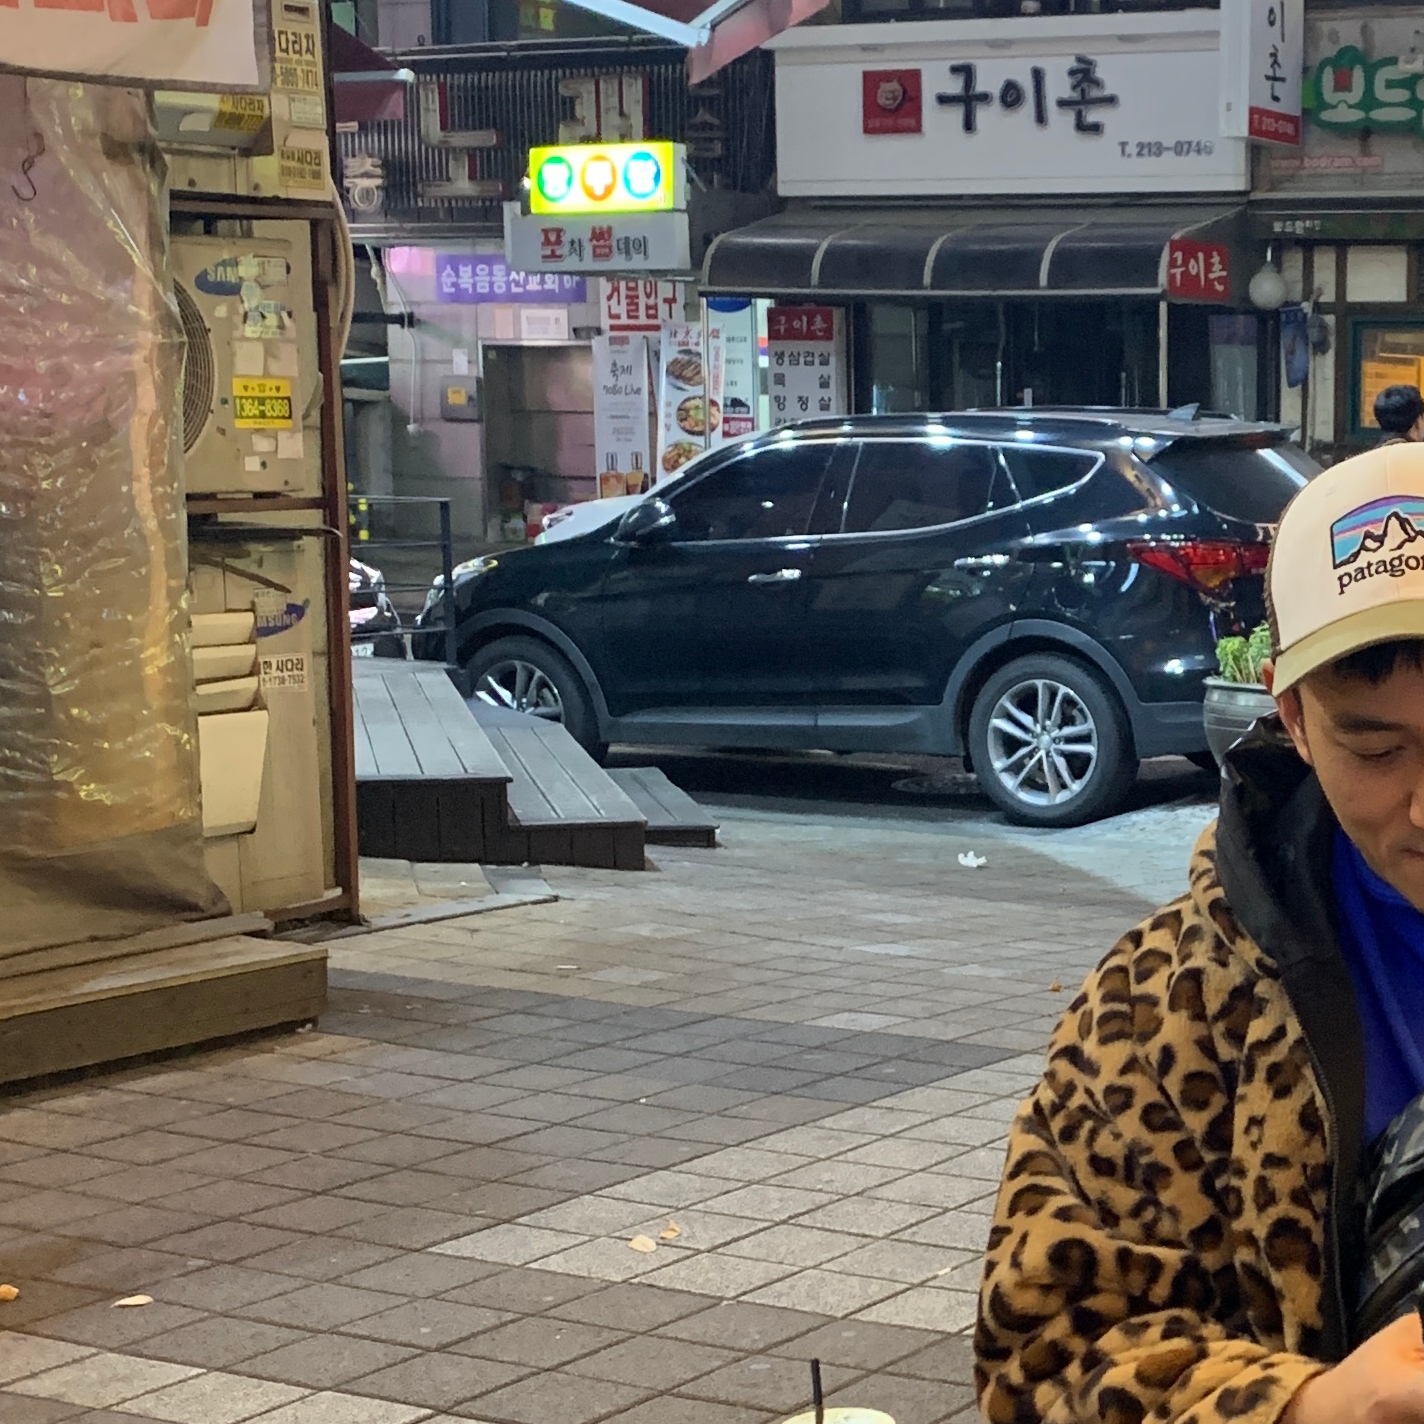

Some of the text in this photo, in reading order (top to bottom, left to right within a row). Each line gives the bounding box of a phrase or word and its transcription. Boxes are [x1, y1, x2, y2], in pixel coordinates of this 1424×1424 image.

[277, 29, 316, 59] 다리차
[934, 53, 1120, 134] 구이촌
[540, 226, 586, 264] 포차
[1169, 250, 1228, 292] 구이촌
[773, 313, 829, 337] 구이촌
[773, 350, 831, 367] 생삼겹살
